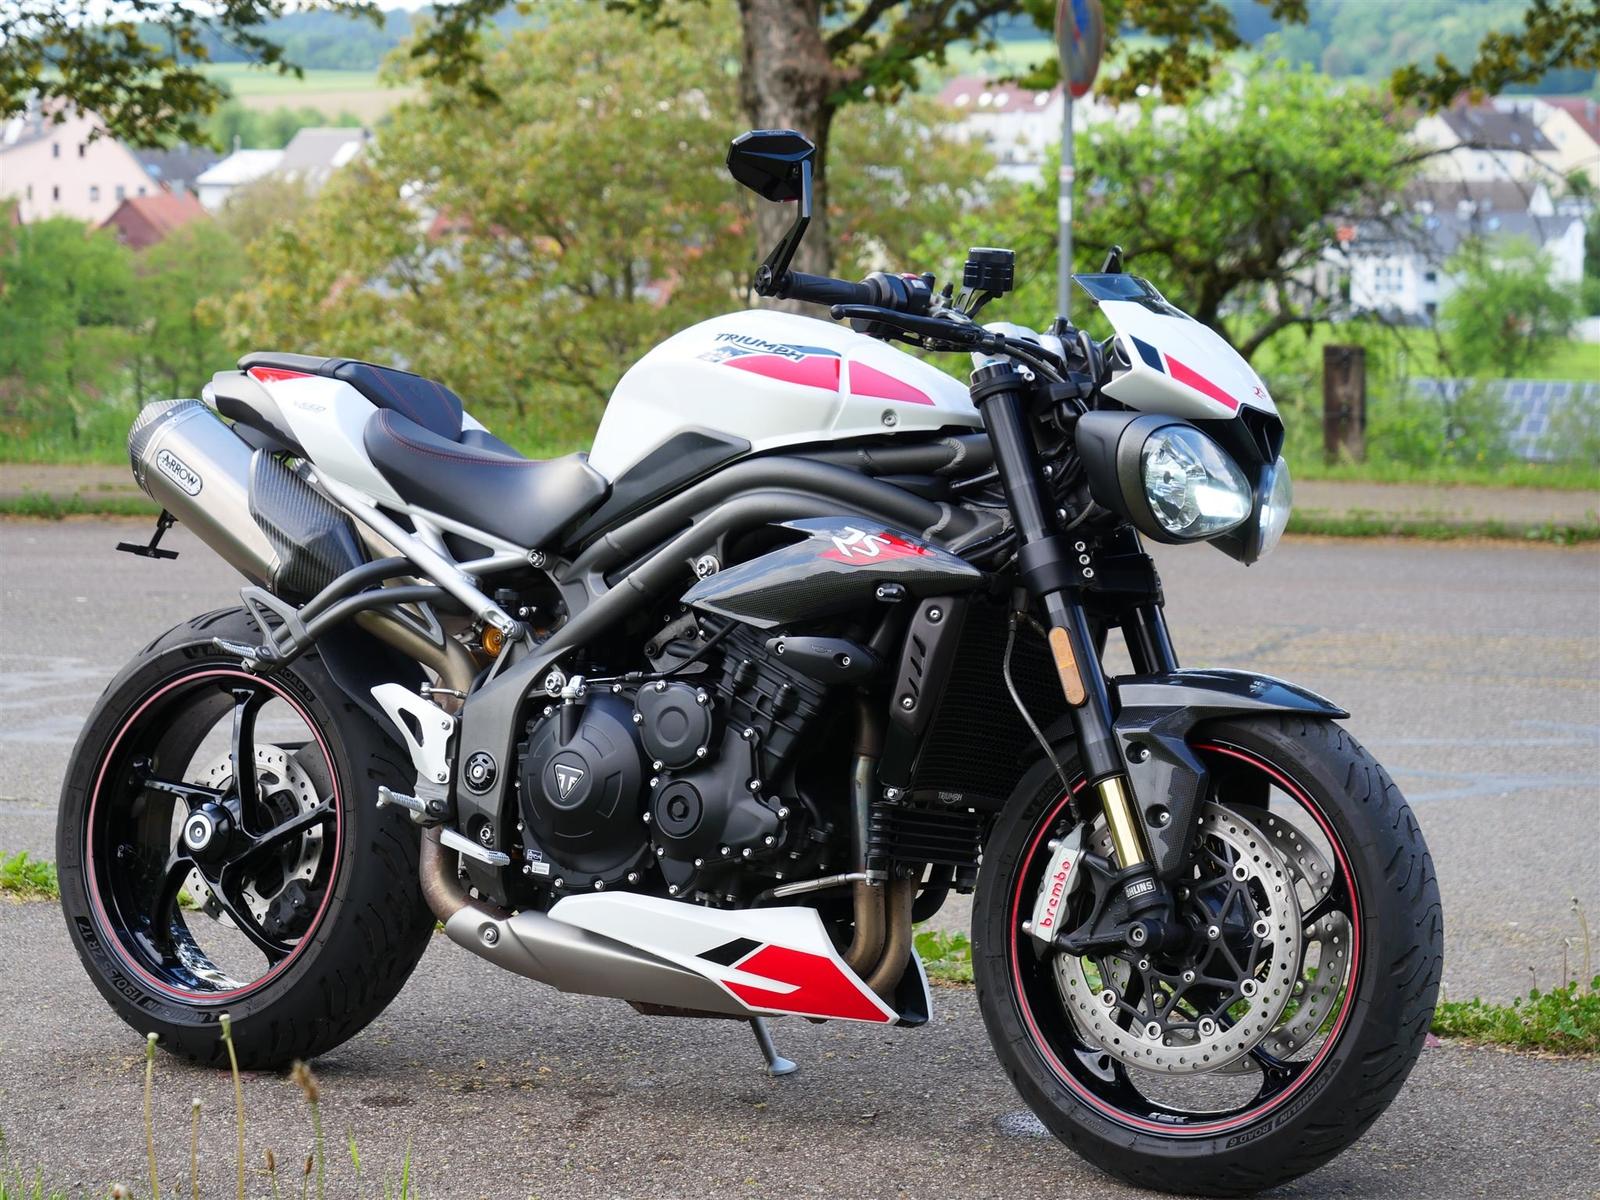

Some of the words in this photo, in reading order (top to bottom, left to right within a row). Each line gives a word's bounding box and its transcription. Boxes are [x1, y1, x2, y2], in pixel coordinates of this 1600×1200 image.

[714, 332, 805, 361] TRIUMPH
[161, 454, 198, 487] ARROW
[831, 526, 891, 557] RS
[1040, 860, 1071, 929] brembo
[1279, 1078, 1327, 1124] MICHELIN
[1239, 1123, 1270, 1143] ROAD
